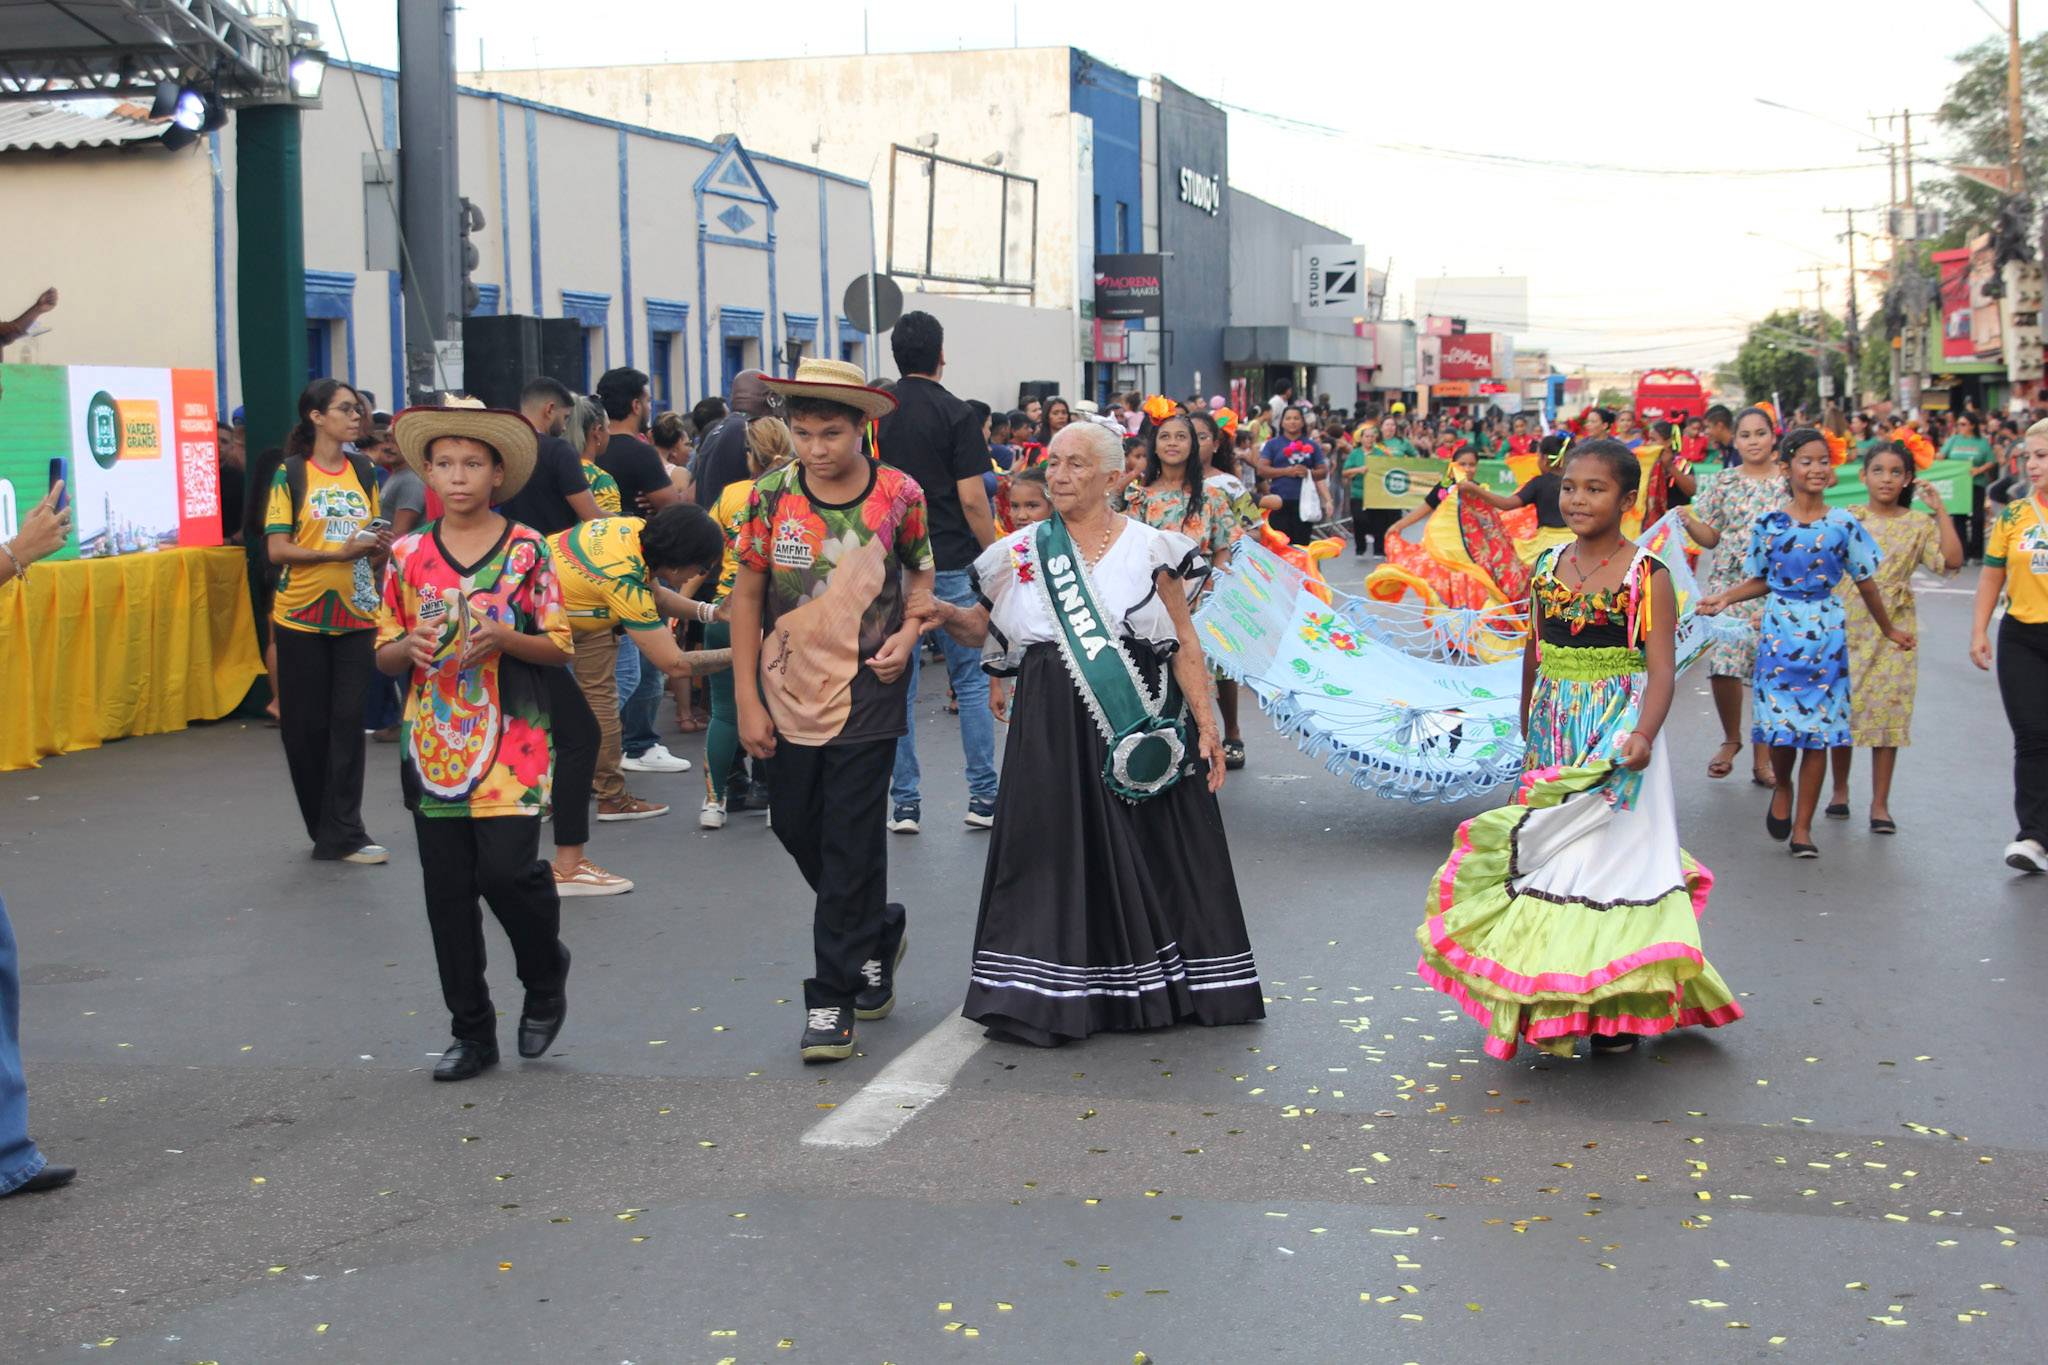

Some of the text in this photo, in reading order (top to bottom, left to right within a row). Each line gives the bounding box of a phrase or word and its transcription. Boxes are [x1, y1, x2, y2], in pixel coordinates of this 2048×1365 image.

[1180, 166, 1212, 212] STUDIO
[1309, 257, 1320, 308] STUDIO
[775, 543, 811, 557] AMFMT
